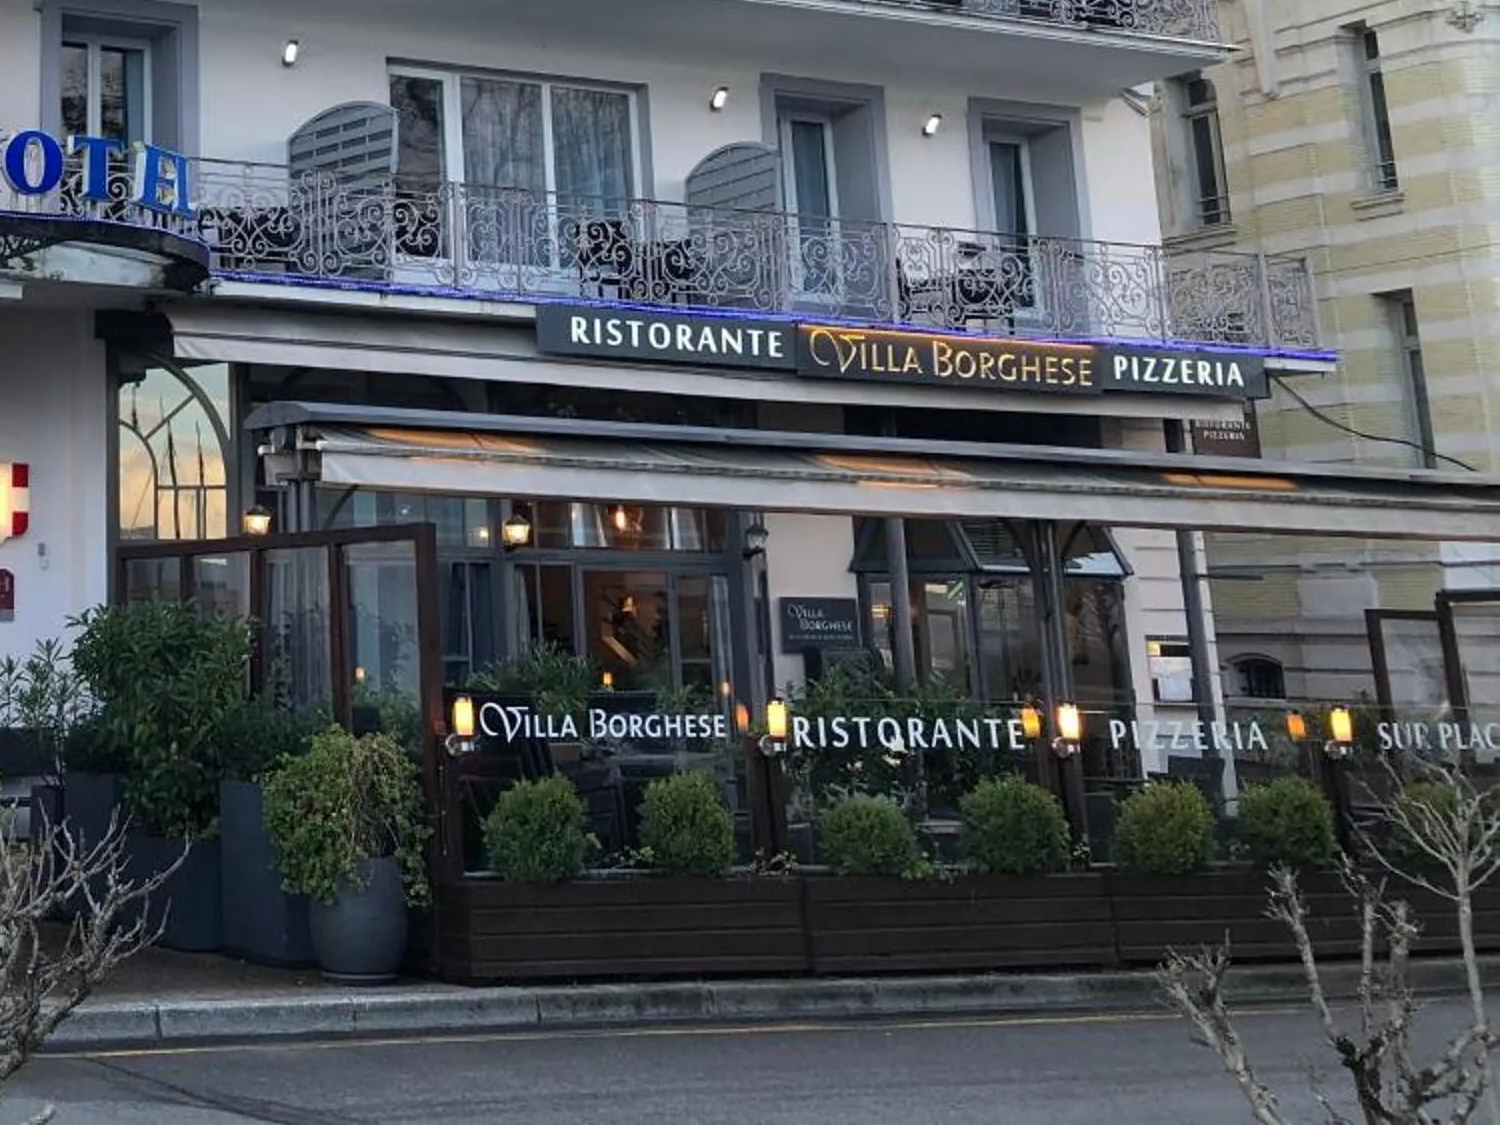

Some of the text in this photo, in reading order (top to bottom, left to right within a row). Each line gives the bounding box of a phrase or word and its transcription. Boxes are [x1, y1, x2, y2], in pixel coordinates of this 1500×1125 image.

[569, 315, 786, 359] RISTORANTE
[809, 328, 1094, 388] VILLA BORGHESE
[1113, 355, 1246, 388] PIZZERIA
[479, 702, 727, 743] VILLA BORGHESE
[793, 716, 1025, 750] RISTORANTE
[1109, 719, 1269, 751] PIZZERIA
[1377, 721, 1432, 751] SUR
